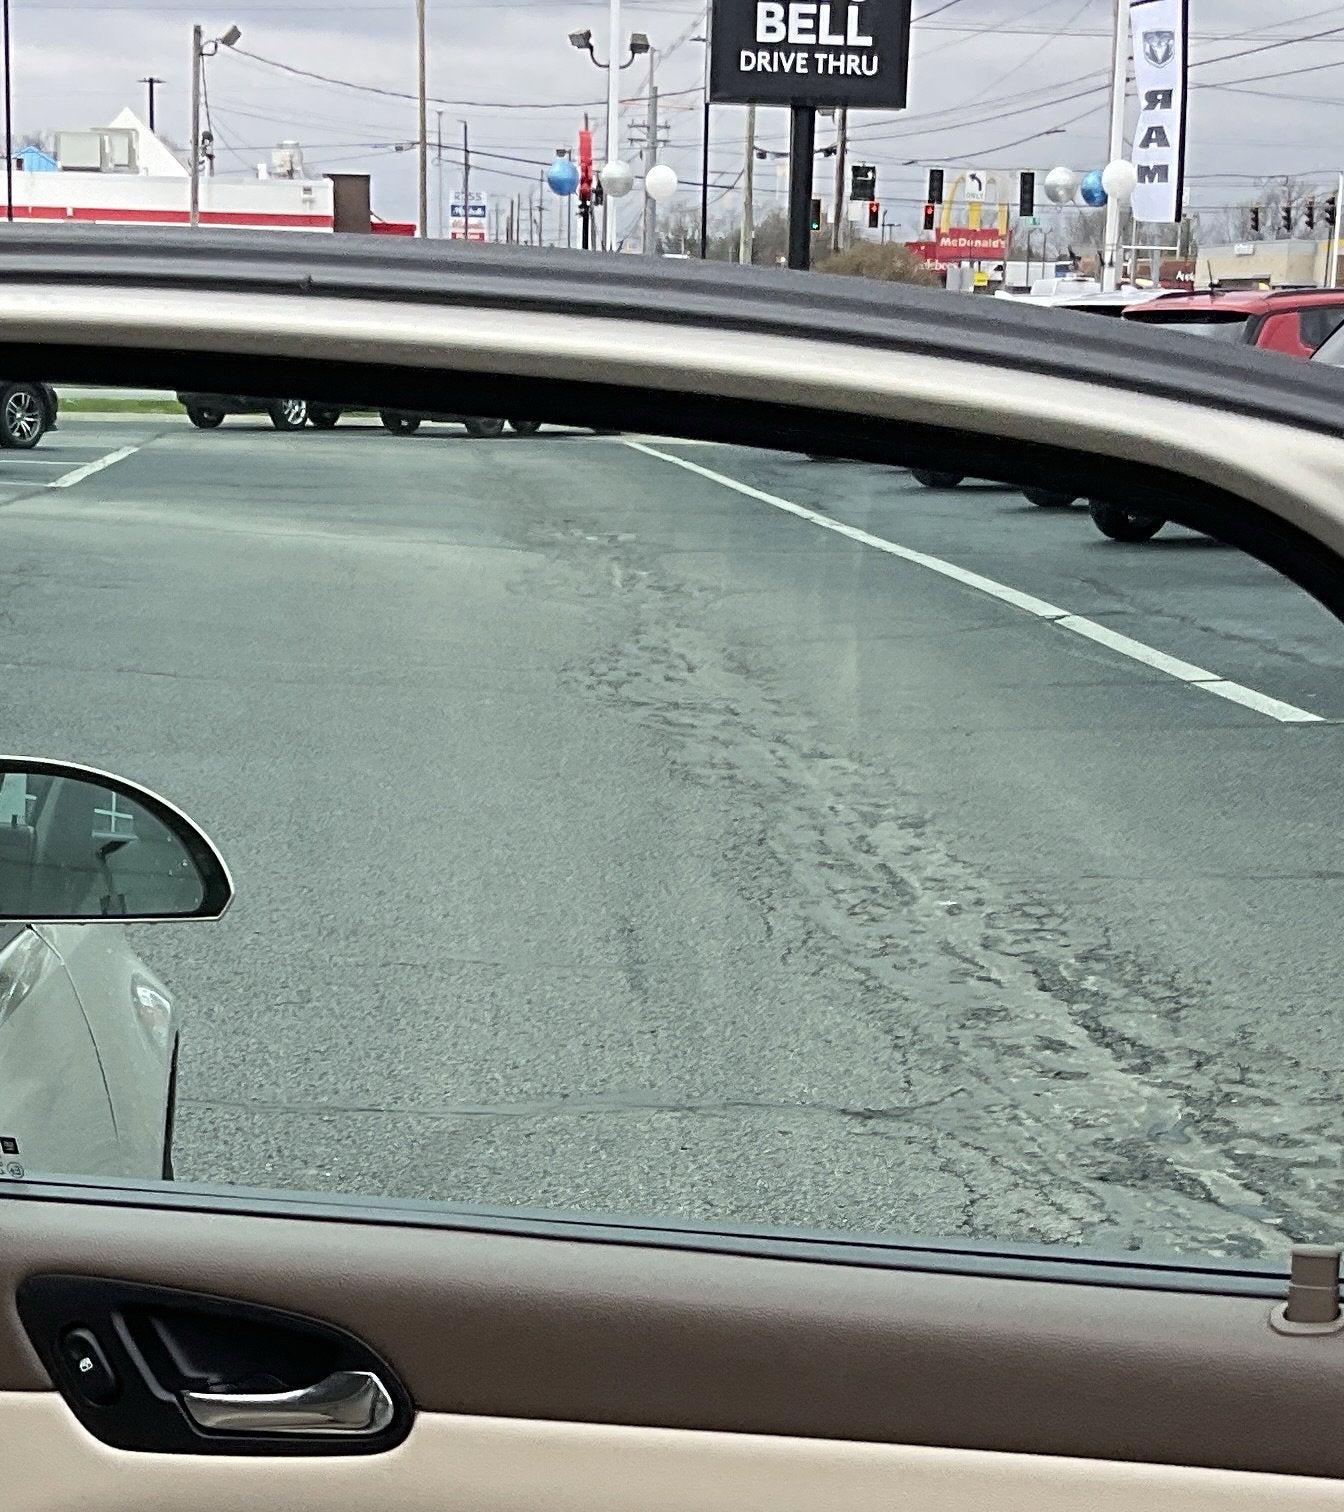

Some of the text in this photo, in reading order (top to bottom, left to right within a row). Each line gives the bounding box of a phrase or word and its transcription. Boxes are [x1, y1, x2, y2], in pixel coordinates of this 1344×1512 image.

[756, 1, 873, 47] BELL
[740, 50, 878, 76] DRIVE THRU
[940, 237, 1006, 249] McDonald's
